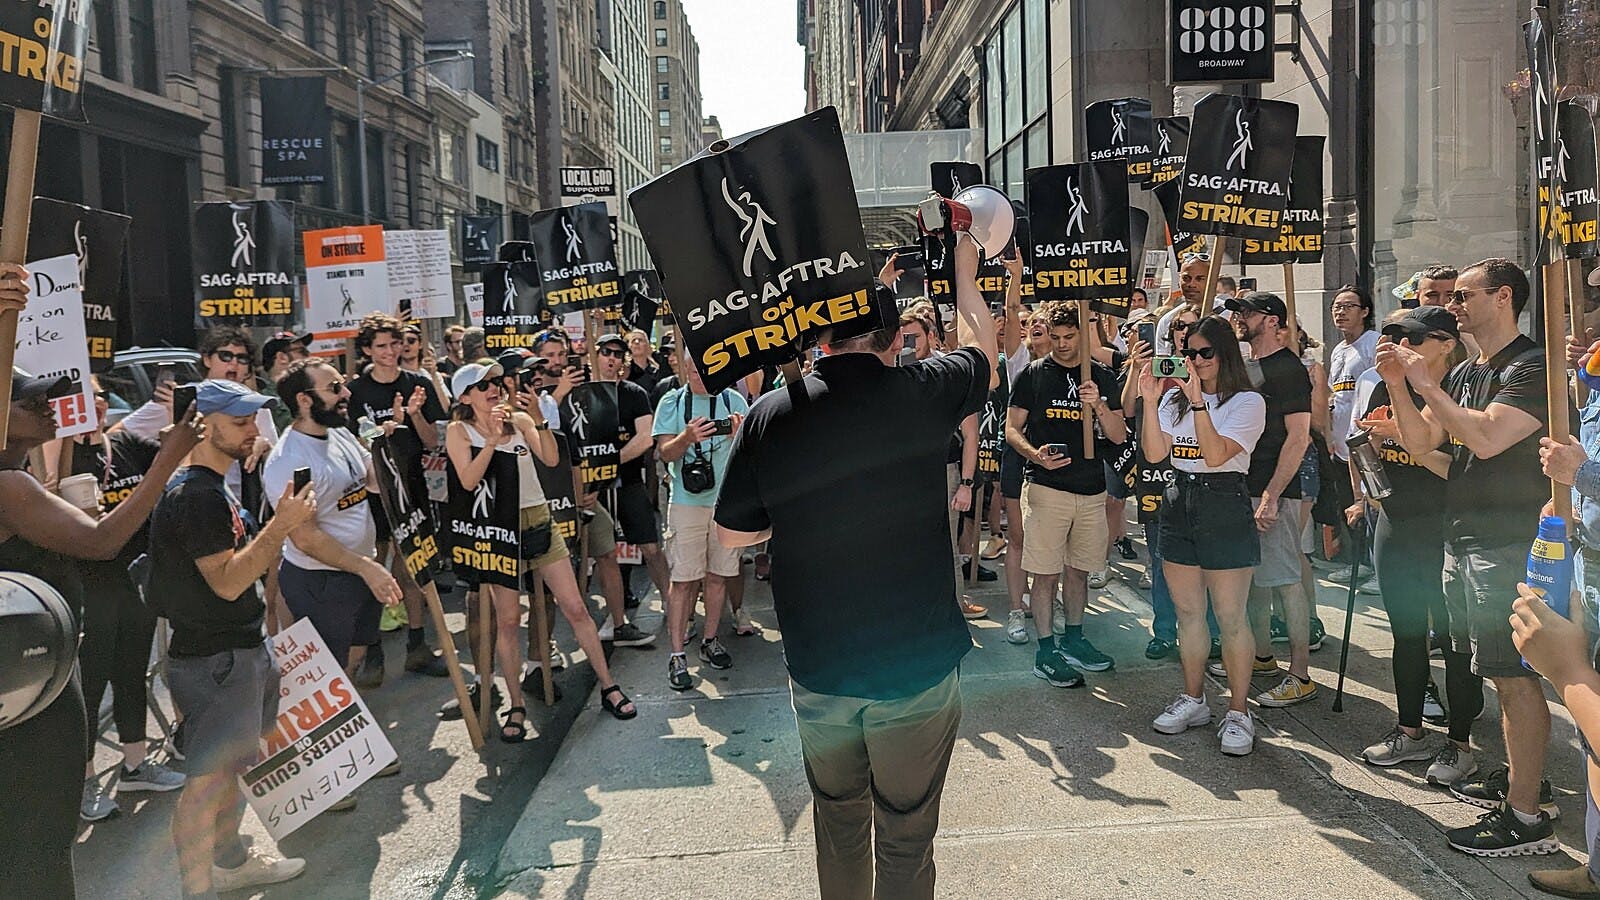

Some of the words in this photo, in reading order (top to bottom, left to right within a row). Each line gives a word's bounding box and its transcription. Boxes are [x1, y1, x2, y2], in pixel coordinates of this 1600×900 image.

[1180, 6, 1265, 53] 888
[1199, 60, 1245, 68] BROADWAY
[264, 138, 323, 149] RESCUE
[278, 151, 307, 161] SPA
[562, 169, 592, 186] LOCAL
[1223, 194, 1242, 205] ON
[1183, 201, 1280, 229] STRIKE!
[334, 242, 366, 257] STRIKE
[1070, 259, 1088, 268] ON
[572, 277, 587, 286] ON
[1036, 267, 1127, 288] STRIKE!
[234, 288, 254, 297] ON
[546, 281, 619, 306] STRIKE!
[42, 307, 65, 319] on
[200, 297, 291, 317] STRIKE!
[762, 295, 794, 322] ON
[702, 289, 871, 375] STRIKE!
[979, 450, 992, 458] ON
[474, 542, 491, 551] ON
[453, 546, 517, 577] STRIKE!
[295, 665, 327, 685] The
[295, 736, 312, 753] ON
[302, 715, 370, 767] WRITERS
[251, 765, 301, 798] GUILD
